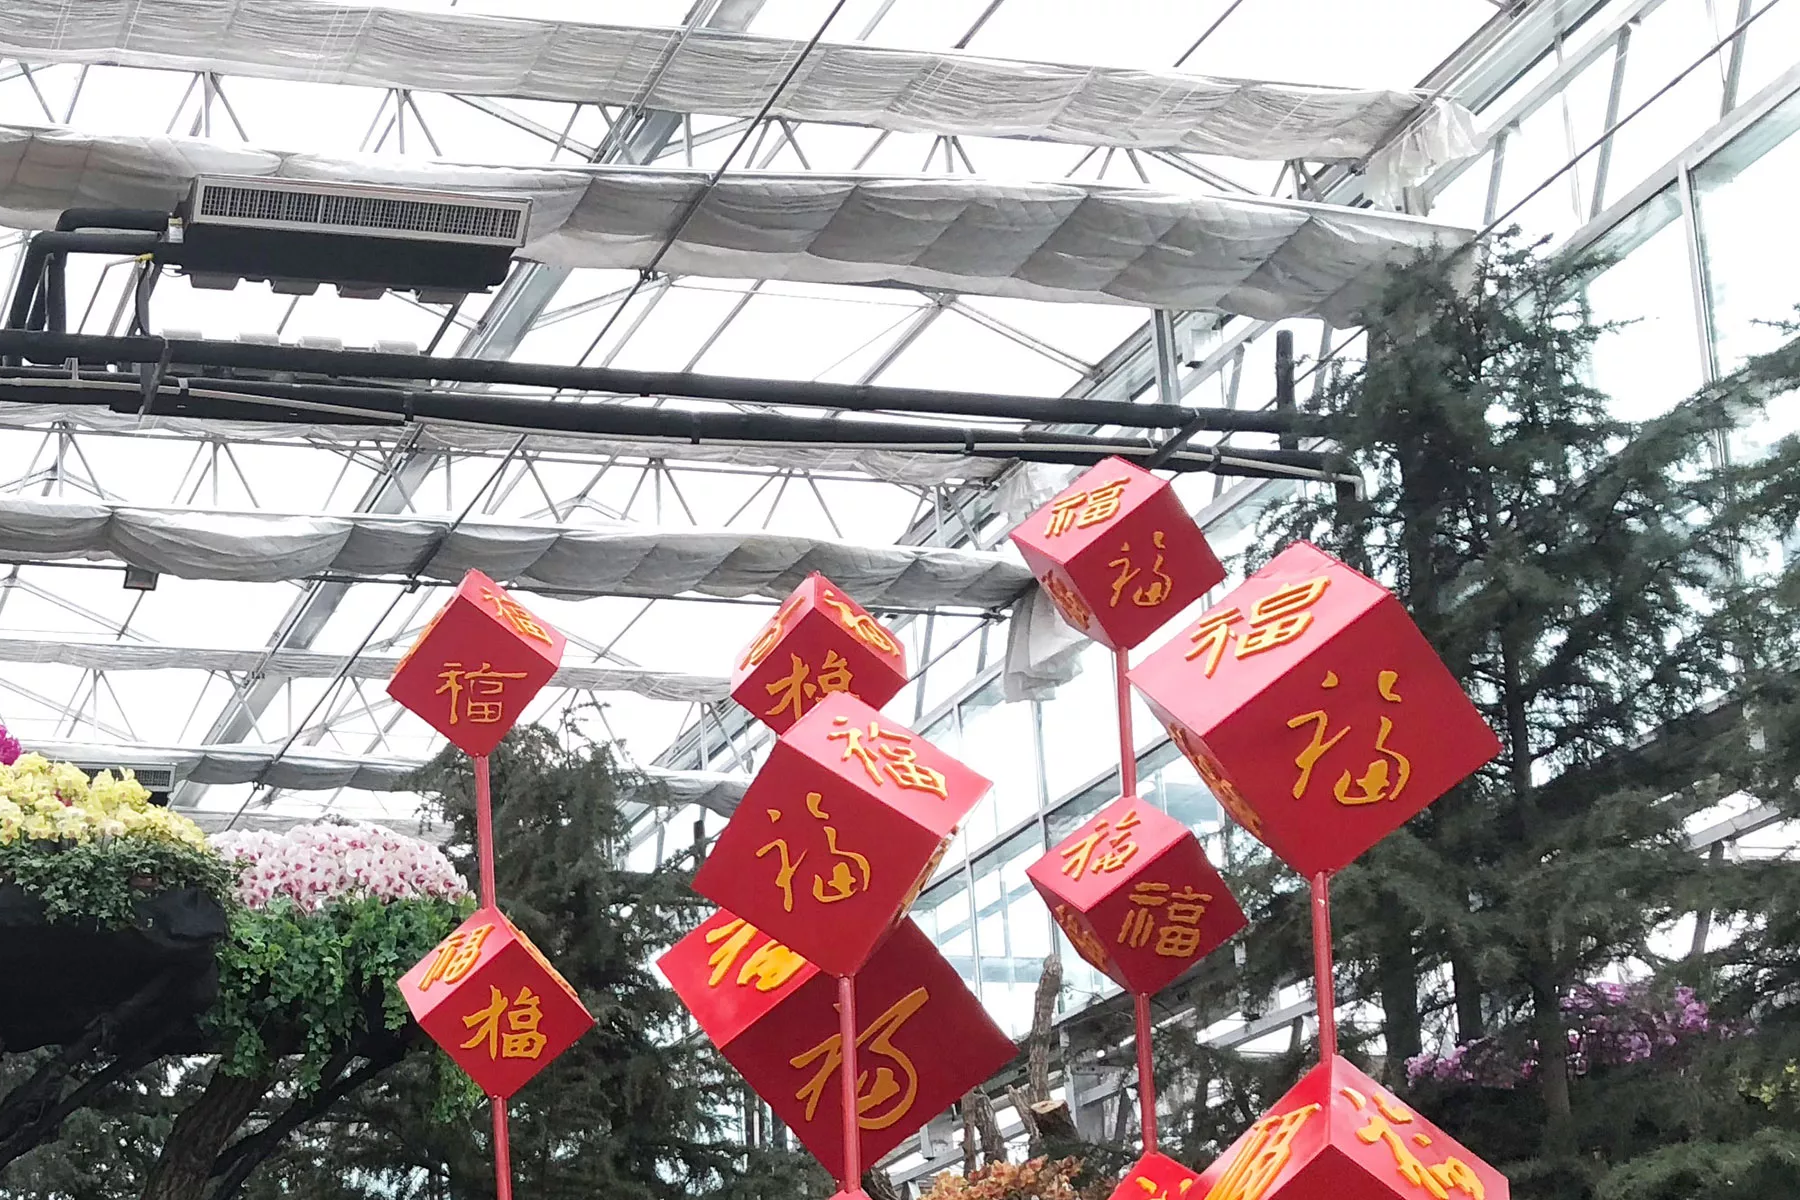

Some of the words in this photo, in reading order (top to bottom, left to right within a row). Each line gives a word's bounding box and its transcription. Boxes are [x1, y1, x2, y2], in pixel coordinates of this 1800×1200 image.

[1044, 476, 1131, 538] 福
[480, 586, 553, 646] 福
[1185, 575, 1331, 679] 福
[436, 662, 528, 724] 福
[827, 715, 948, 801] 福
[1060, 810, 1141, 882] 福
[1117, 881, 1212, 958] 福
[418, 923, 496, 992] 福
[460, 985, 547, 1061] 福
